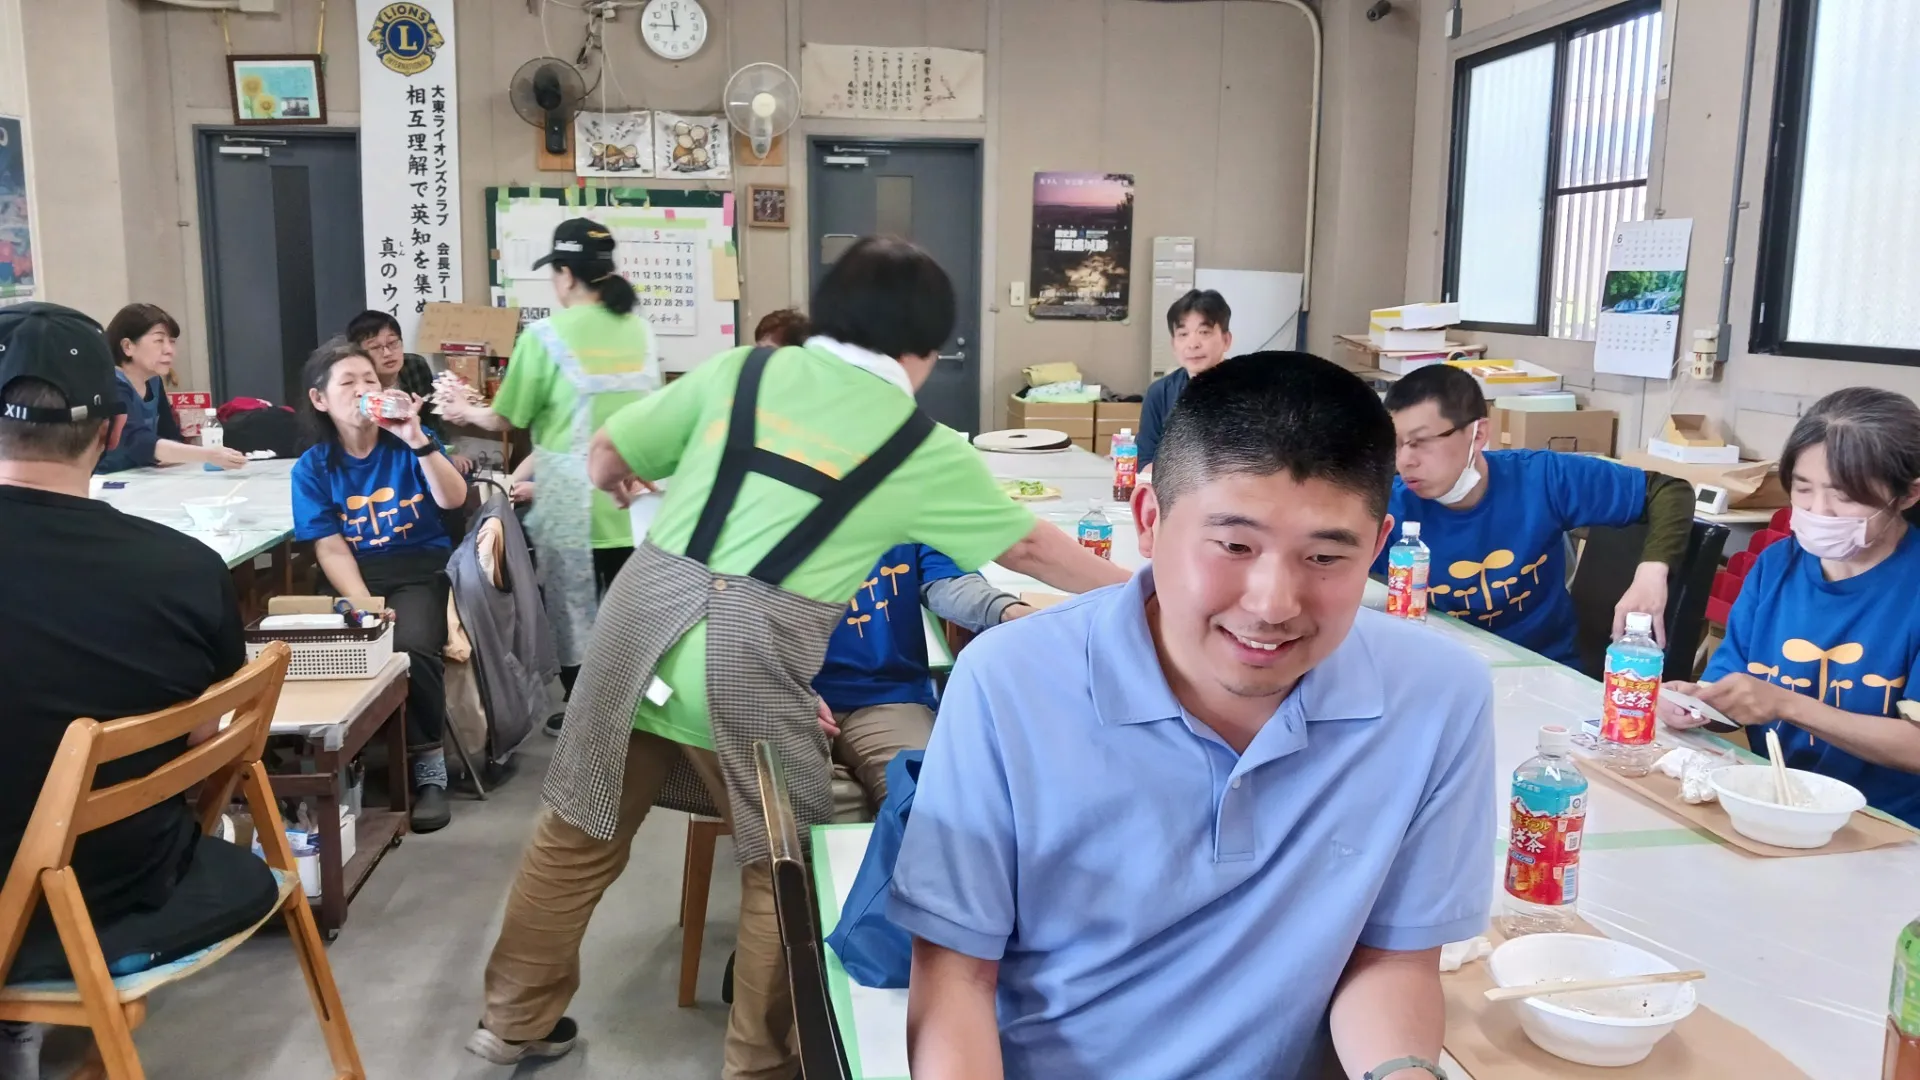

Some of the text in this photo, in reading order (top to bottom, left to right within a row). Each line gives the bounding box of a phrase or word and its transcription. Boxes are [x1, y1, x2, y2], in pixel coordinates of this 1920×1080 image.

[671, 1, 679, 9] 12
[684, 4, 687, 12] 1
[384, 5, 426, 21] LIONS
[690, 12, 697, 20] 2
[693, 23, 699, 31] 3
[397, 25, 418, 50] L
[653, 33, 660, 41] 8
[671, 44, 679, 52] 6
[682, 42, 689, 50] 5
[406, 84, 432, 313] 相互理解で英知を集め
[431, 85, 451, 303] 大東ライオンズクラブ 会長テー
[654, 230, 660, 240] 5
[1617, 234, 1623, 244] 6
[399, 241, 405, 256] しん
[686, 245, 691, 253] 2
[665, 258, 670, 266] 7
[676, 258, 680, 266] 8
[687, 259, 691, 267] 9
[379, 236, 400, 317] 真のウィ
[622, 271, 630, 279] 10
[643, 271, 650, 279] 12
[653, 271, 661, 279] 13
[664, 272, 672, 280] 14
[674, 272, 682, 280] 15
[685, 286, 693, 294] 23
[643, 298, 651, 306] 26
[664, 299, 672, 307] 28
[675, 299, 683, 307] 29
[1665, 320, 1672, 330] 5
[4, 403, 27, 420] XII
[1611, 688, 1652, 708] むぎ茶
